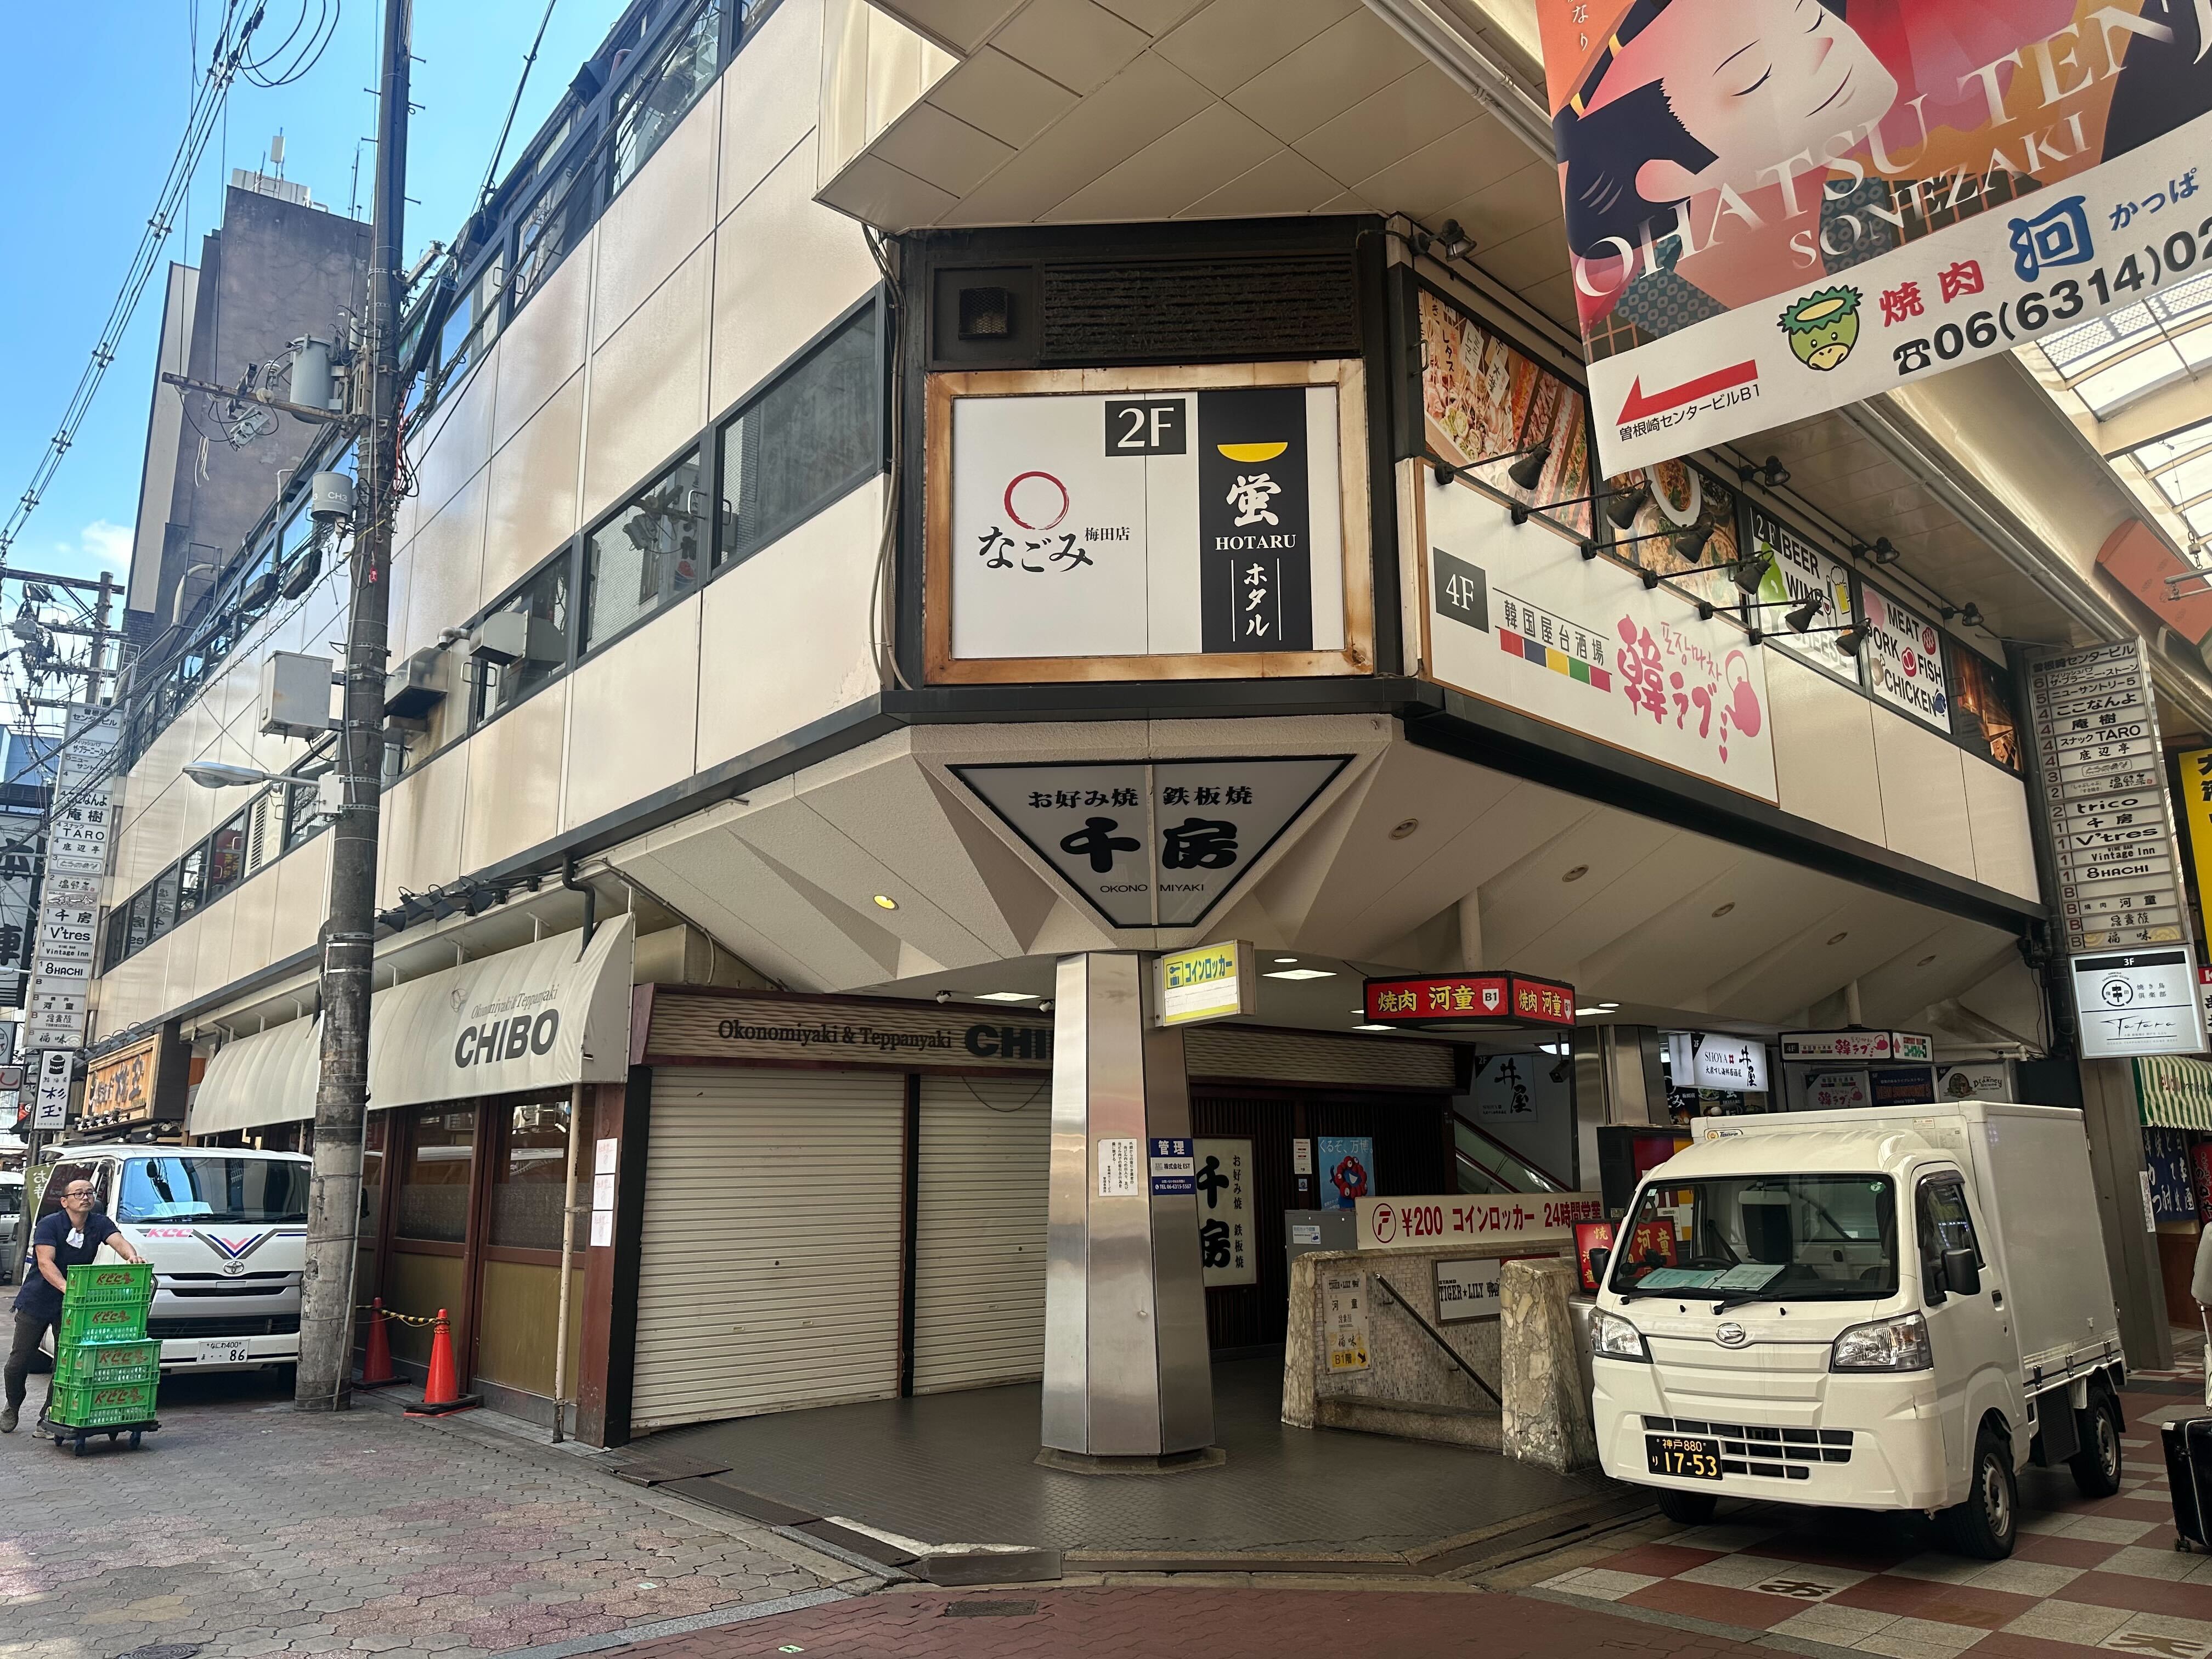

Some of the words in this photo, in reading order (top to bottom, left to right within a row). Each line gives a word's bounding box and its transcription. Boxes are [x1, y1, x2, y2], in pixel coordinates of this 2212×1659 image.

[1567, 0, 1588, 52] なり
[1575, 93, 1928, 297] OHATSU
[1787, 111, 2091, 269] SONEZAKI
[1879, 259, 1984, 328] 焼肉
[2108, 167, 2199, 231] かっぱ
[1117, 407, 1175, 448] 2F
[1226, 473, 1282, 527] 蛍
[1215, 534, 1297, 550] HOTARU
[1756, 514, 1776, 546] 2F
[978, 526, 1094, 573] なごみ
[1084, 526, 1130, 541] 梅田店
[1781, 537, 1820, 580] BEER
[1243, 562, 1270, 637] ホタル
[1446, 573, 1475, 612] 4F
[1504, 600, 1604, 666] 韓国屋台酒場
[1887, 603, 1920, 642] MEAT
[1661, 621, 1723, 682] 포장마차
[1867, 628, 1900, 662] PORK
[1918, 655, 1944, 687] FISH
[2033, 645, 2135, 673] 曽根崎センタービル
[1884, 673, 1937, 717] CHICKEN
[2034, 678, 2044, 688] 6
[2036, 693, 2046, 704] 5
[2052, 677, 2136, 699] ニューサントリー5
[2039, 709, 2049, 719] 4
[2057, 693, 2137, 716] ここなんよ
[2041, 725, 2051, 735] 4
[2072, 713, 2117, 731] 庵樹
[2043, 741, 2053, 751] 4
[2061, 735, 2094, 747] スナック
[2096, 725, 2141, 742] TARO
[2045, 757, 2056, 766] 4
[2080, 743, 2130, 761] 底辺亭
[2048, 772, 2058, 782] 3
[1028, 788, 1139, 808] お好み焼
[1162, 786, 1253, 806] 鉄板焼
[2051, 788, 2059, 798] 2
[66, 809, 103, 823] 庵樹
[2053, 806, 2063, 817] 2
[2077, 798, 2138, 814] trico
[63, 828, 105, 840] TARO
[2057, 823, 2062, 833] 1
[2087, 814, 2132, 828] 千房
[62, 843, 100, 853] 底辺亭
[1059, 816, 1238, 873] 千房
[2058, 839, 2064, 849] 1
[2061, 855, 2067, 865] 1
[2091, 849, 2134, 862] Vintage
[2138, 847, 2155, 856] Inn
[1099, 884, 1148, 893] OKONO
[1159, 883, 1205, 893] MIYAKI
[2063, 871, 2070, 882] 1
[2064, 887, 2075, 898] B
[2067, 904, 2077, 915] B
[2120, 895, 2157, 909] 河童
[55, 909, 93, 924] 千房
[2069, 920, 2081, 930] B
[2071, 937, 2081, 947] B
[2107, 929, 2152, 944] 福味
[46, 948, 75, 957] Vintage
[1184, 956, 1233, 984] コインロッカー
[1378, 989, 1417, 1013] 焼肉
[1428, 985, 1475, 1012] 河童
[1485, 992, 1499, 1003] B1
[1519, 988, 1538, 1013] 焼肉
[1541, 990, 1562, 1018] 河童
[1564, 1001, 1571, 1012] B1
[455, 1009, 558, 1068] CHIBO
[719, 1020, 838, 1047] Okonomiyaki
[842, 1028, 856, 1042] &
[860, 1028, 952, 1051] Teppanyaki
[964, 1024, 1054, 1059] CHI
[2100, 1015, 2176, 1039] Tatara
[1705, 1052, 1728, 1063] SHOYA
[41, 1087, 66, 1118] 杉玉
[1158, 1140, 1185, 1155] 管理
[1320, 1139, 1373, 1153] くるぞ、万博。
[1233, 1155, 1242, 1210] お好み焼
[1196, 1155, 1231, 1268] 千房
[1402, 1206, 1443, 1238] ¥200
[1452, 1206, 1535, 1232] コインロッカー
[1544, 1200, 1602, 1228] 24時間営業
[146, 1229, 192, 1237] KCC
[1234, 1224, 1244, 1268] 鉄板焼
[1439, 1284, 1463, 1302] TIGER
[1468, 1283, 1483, 1299] LILY
[229, 1349, 245, 1361] 86
[1335, 1353, 1352, 1364] B1階
[1662, 1438, 1702, 1452] 神戸880
[1652, 1455, 1658, 1466] り
[1665, 1452, 1717, 1476] 17-53
